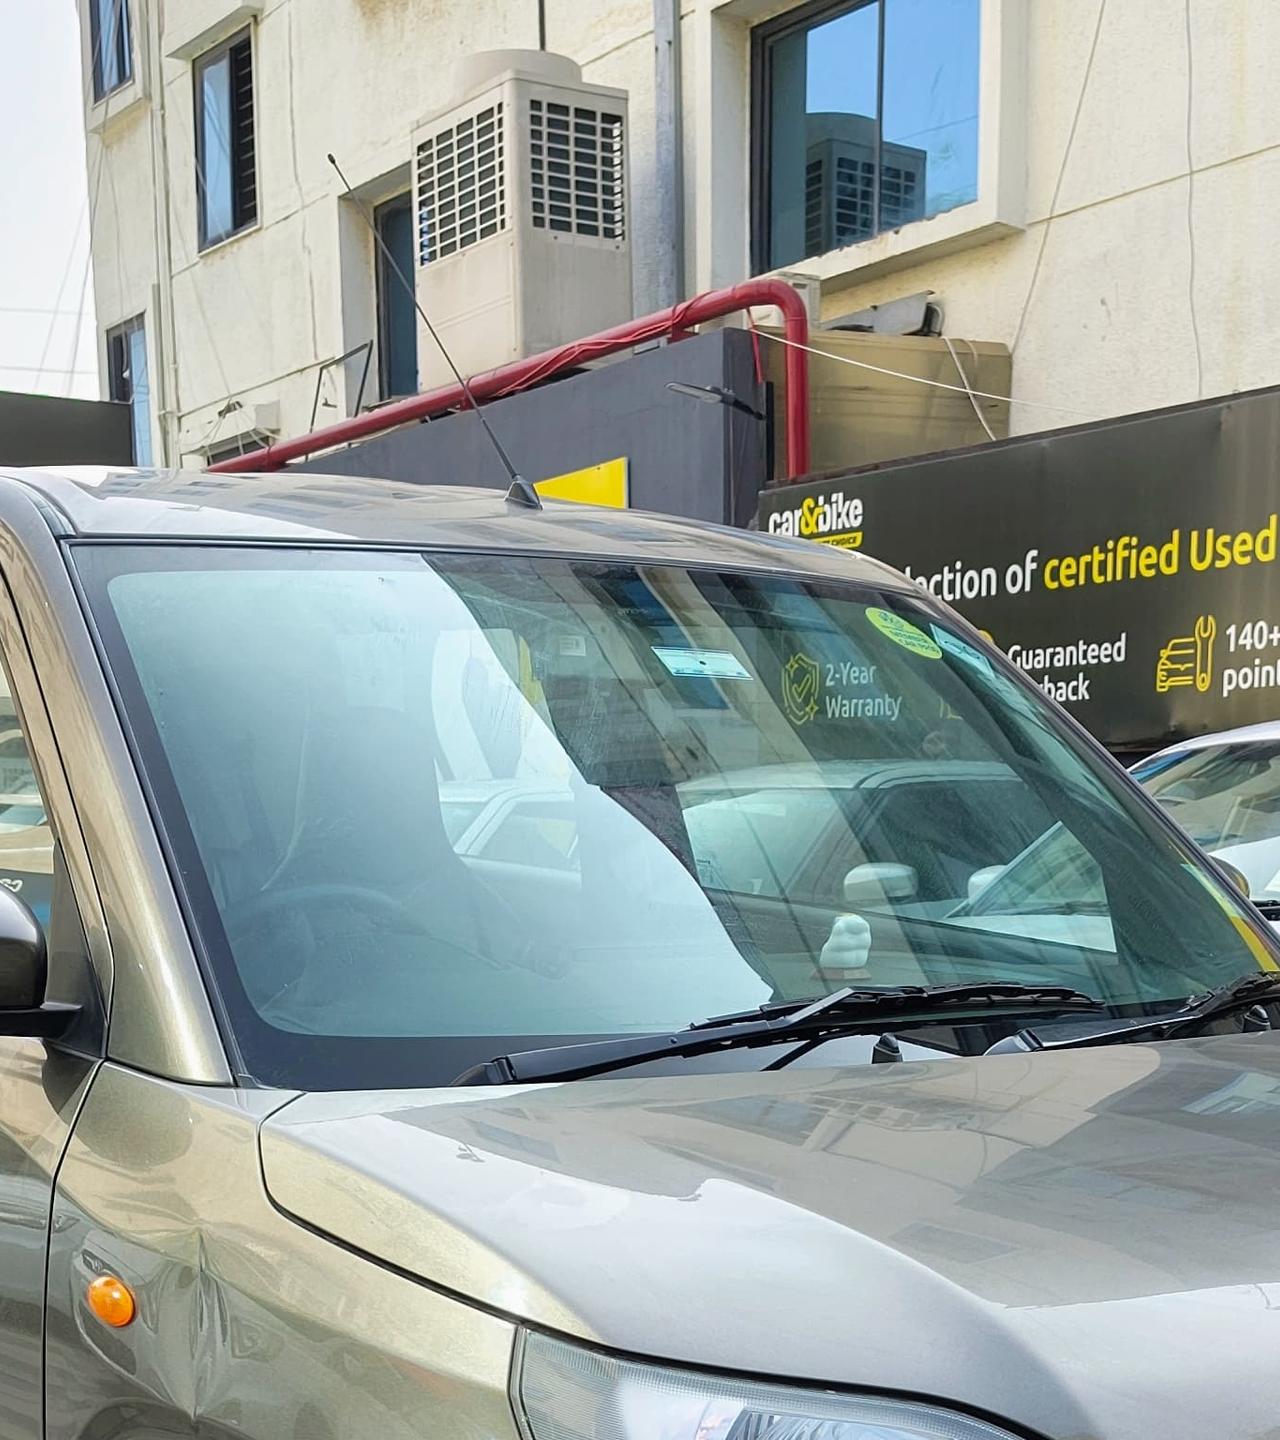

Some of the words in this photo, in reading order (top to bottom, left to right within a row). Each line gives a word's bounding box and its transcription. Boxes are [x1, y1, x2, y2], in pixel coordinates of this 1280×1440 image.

[1005, 549, 1038, 595] of
[1043, 528, 1180, 591] certified
[1188, 514, 1277, 572] Used
[825, 663, 877, 687] 2-Year
[825, 695, 903, 722] Warranty
